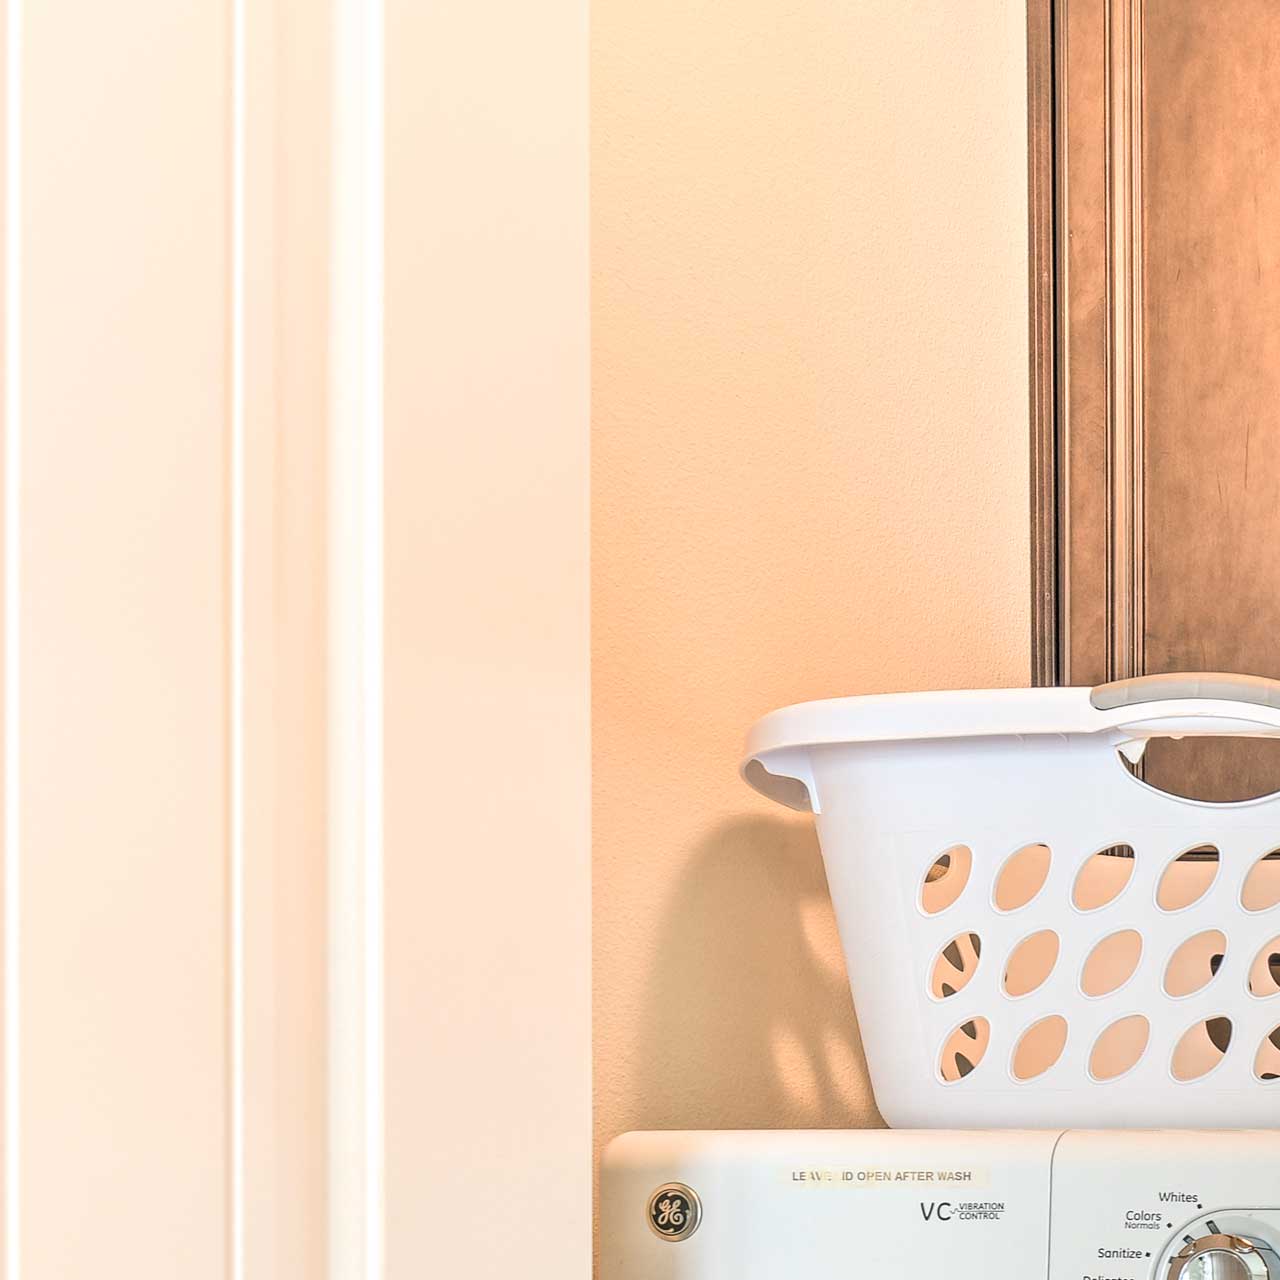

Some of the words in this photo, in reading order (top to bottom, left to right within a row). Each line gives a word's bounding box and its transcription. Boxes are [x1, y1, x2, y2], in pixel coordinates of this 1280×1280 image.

[857, 1171, 891, 1182] OPEN
[894, 1171, 934, 1182] AFTER
[937, 1171, 972, 1182] WASH
[1159, 1191, 1198, 1203] Whites
[920, 1201, 951, 1222] VC
[958, 1202, 1005, 1210] VIBRATION
[958, 1212, 1000, 1221] CONTROL
[1126, 1210, 1162, 1222] Colors
[1125, 1221, 1160, 1230] Normals
[1098, 1248, 1142, 1259] Sanitize
